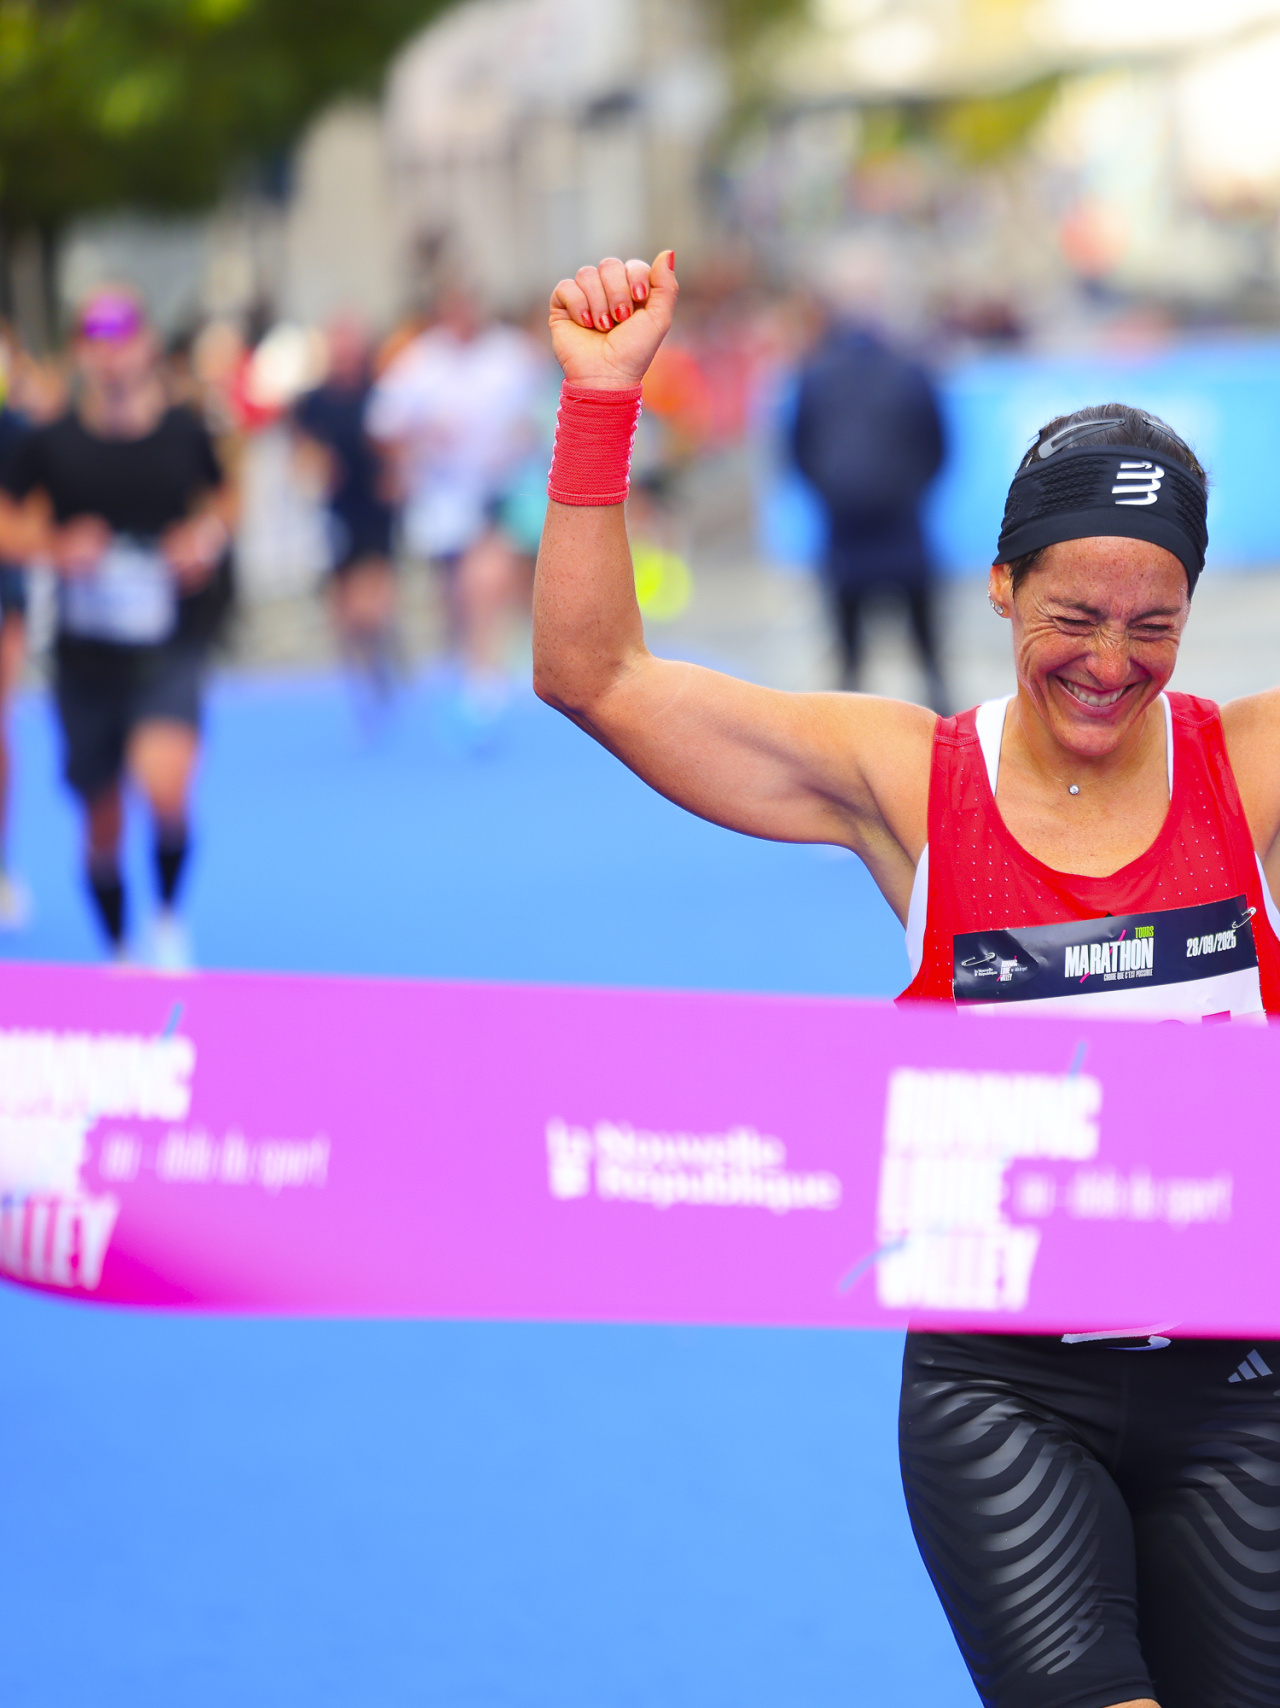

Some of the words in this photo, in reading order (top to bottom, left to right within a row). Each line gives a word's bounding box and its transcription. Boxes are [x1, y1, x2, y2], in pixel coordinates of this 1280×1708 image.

[1134, 926, 1155, 939] TOURS
[1186, 930, 1237, 958] 28/09/2025
[1064, 938, 1154, 978] MARATHON
[590, 1118, 788, 1168] Nouvelle
[594, 1163, 844, 1216] République
